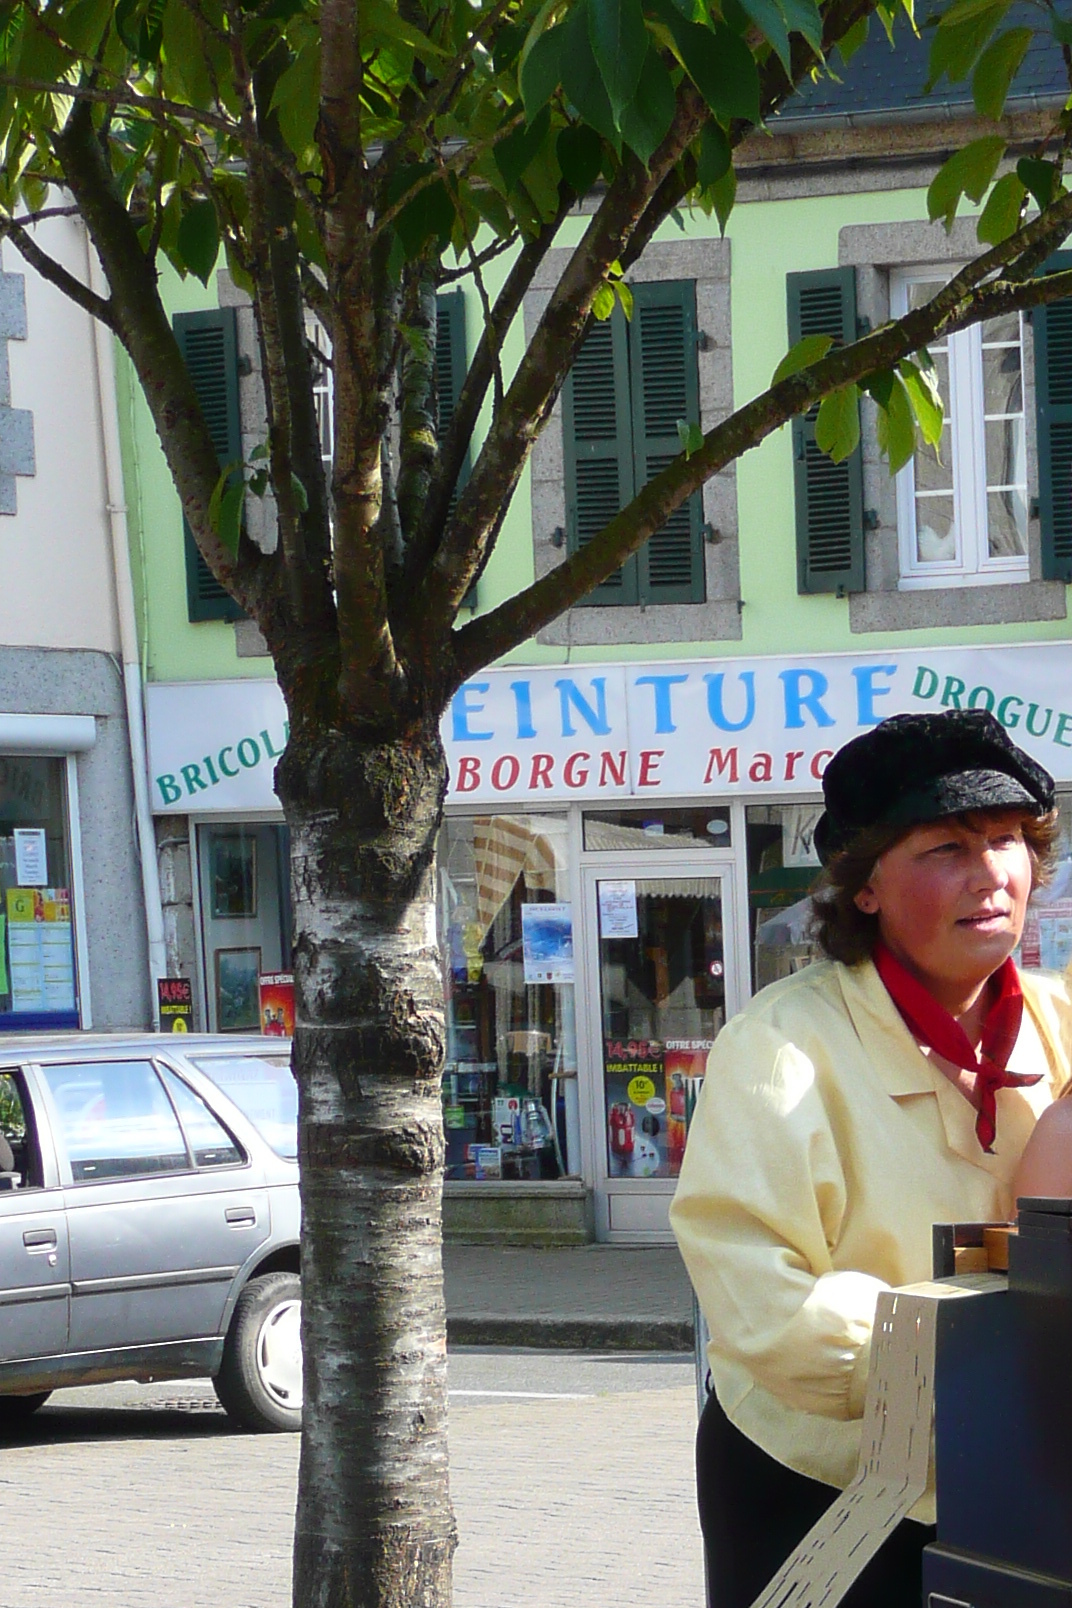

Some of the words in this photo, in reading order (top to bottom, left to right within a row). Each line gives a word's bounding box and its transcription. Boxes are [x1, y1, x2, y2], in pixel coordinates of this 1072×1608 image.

[452, 664, 898, 742] EINTURE
[155, 721, 291, 805] BRICOL
[455, 750, 665, 793] BORGNE
[702, 747, 834, 785] Marc
[691, 1039, 715, 1050] SPÉC
